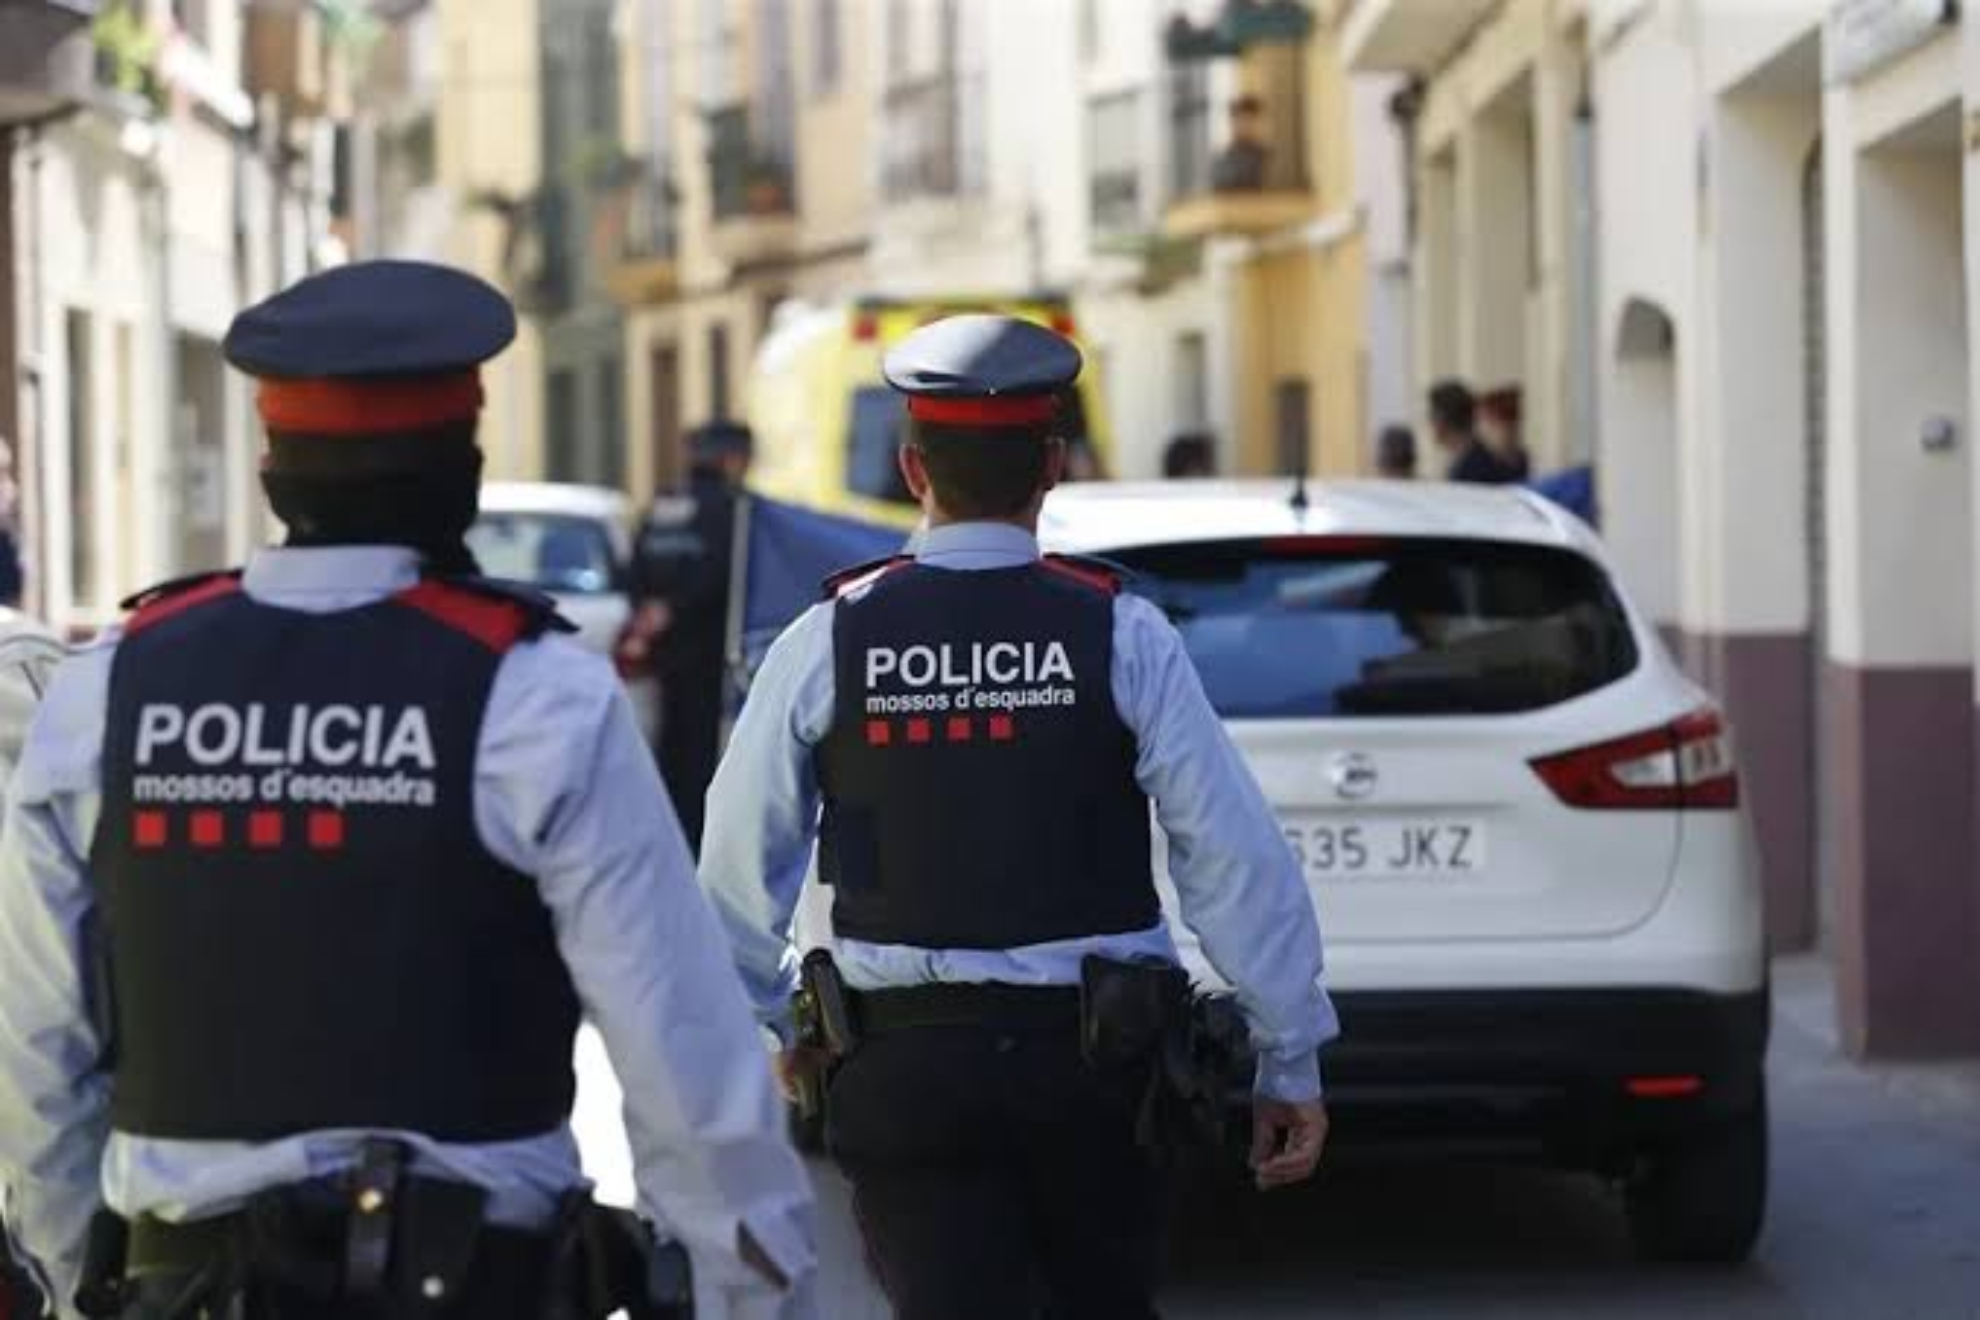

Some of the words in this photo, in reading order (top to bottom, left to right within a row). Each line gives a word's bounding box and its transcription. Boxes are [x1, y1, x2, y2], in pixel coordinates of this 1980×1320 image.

[865, 641, 1075, 687] POLICIA
[866, 693, 951, 713] mossos
[133, 703, 436, 768] POLICIA
[133, 778, 254, 801] mossos
[1387, 826, 1473, 870] JKZ
